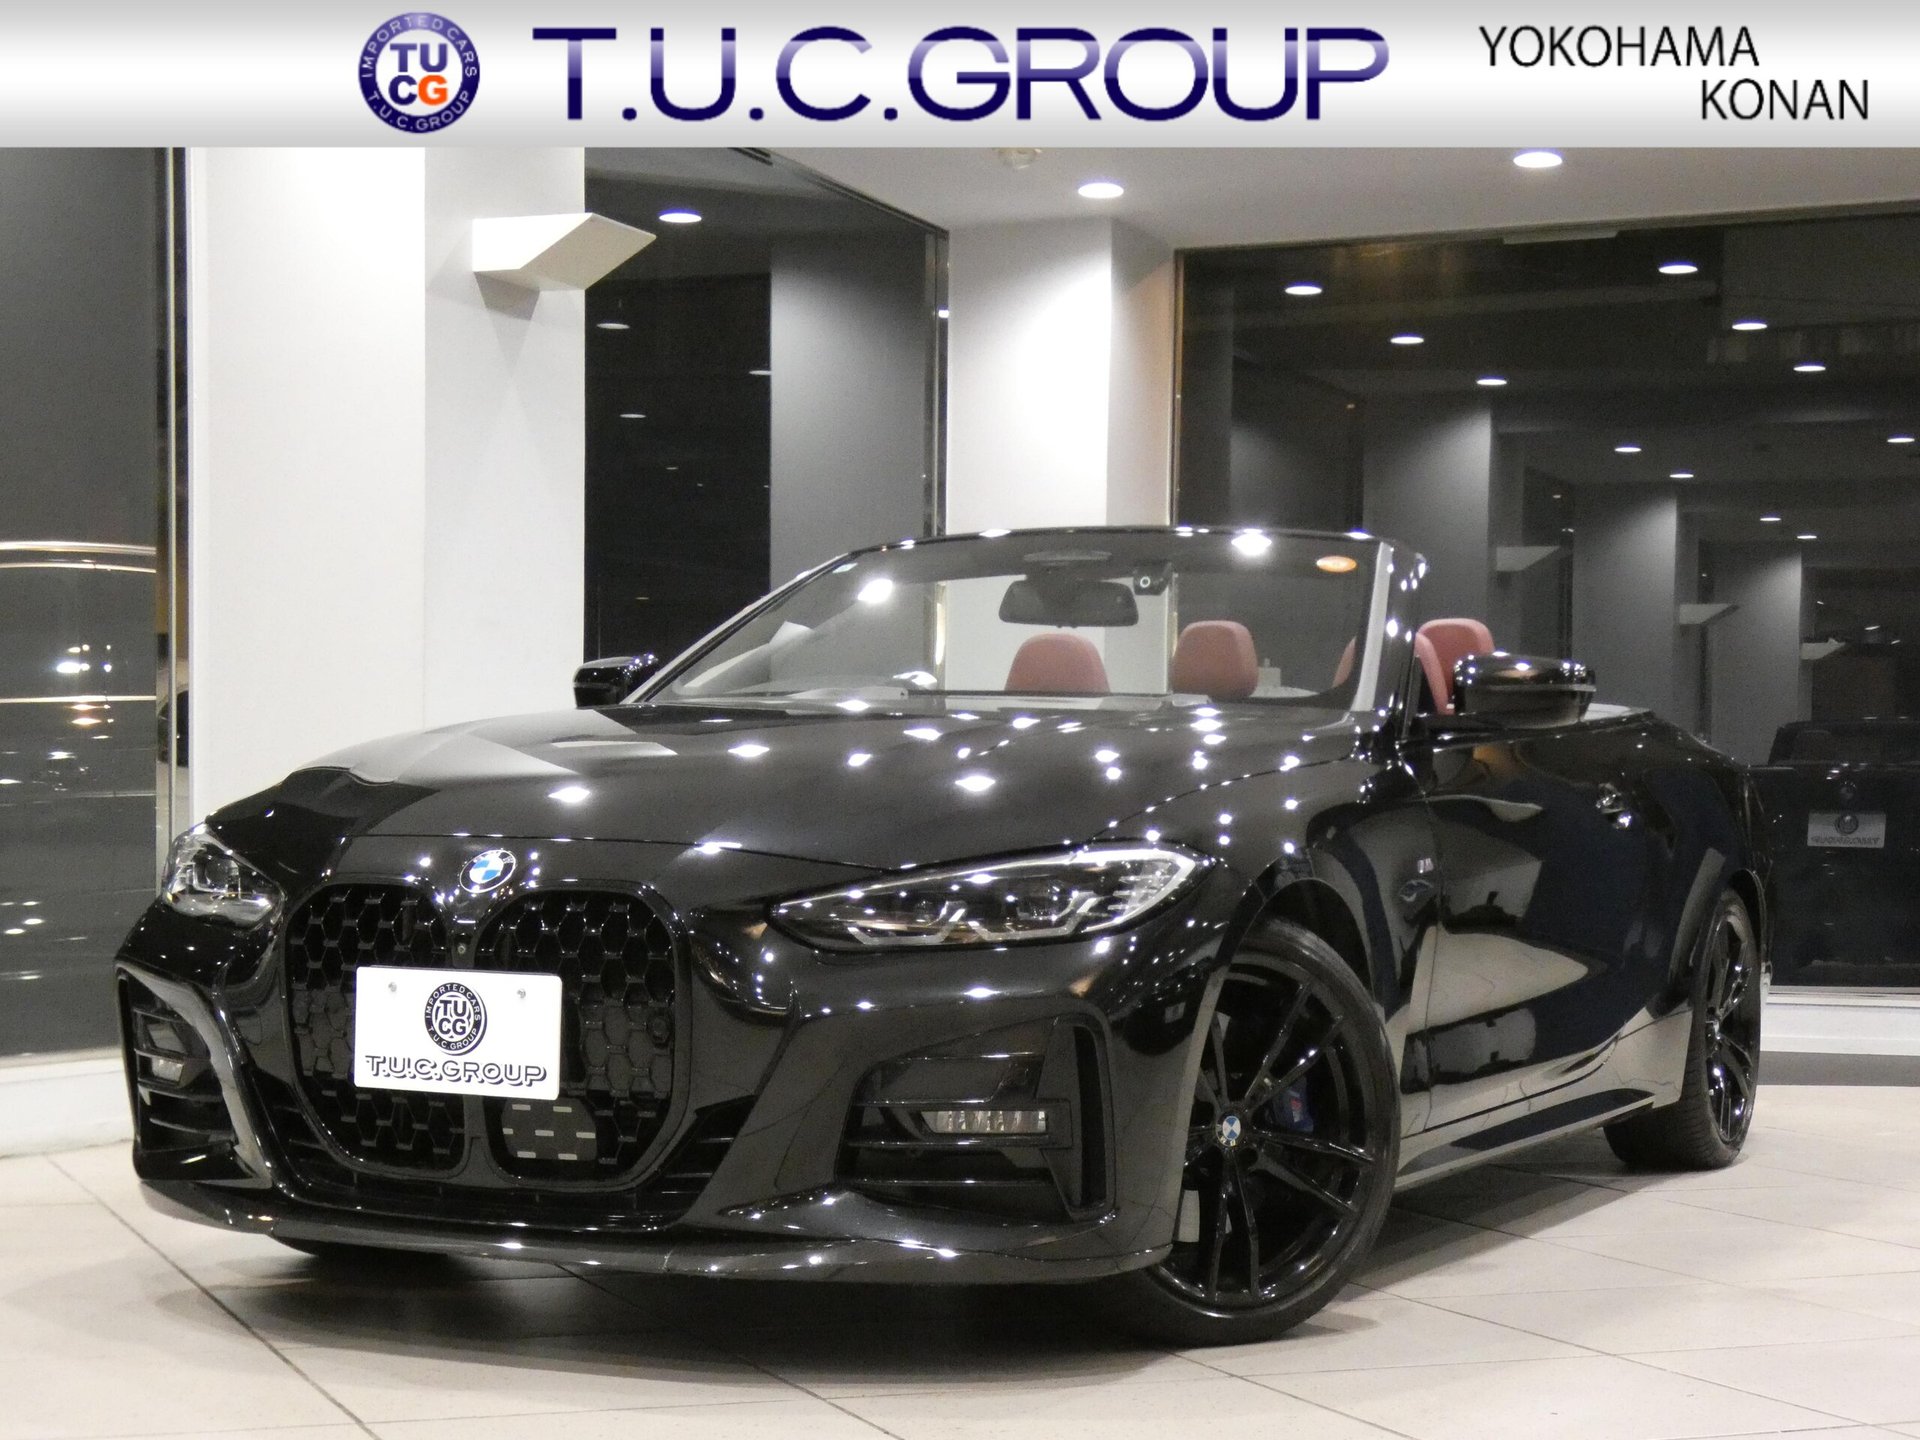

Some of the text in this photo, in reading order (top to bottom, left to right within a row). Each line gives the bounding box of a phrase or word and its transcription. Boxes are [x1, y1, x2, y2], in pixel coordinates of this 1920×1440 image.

[425, 983, 481, 1021] IMPORTED CARS
[365, 1055, 547, 1087] T.U.C.GROUP
